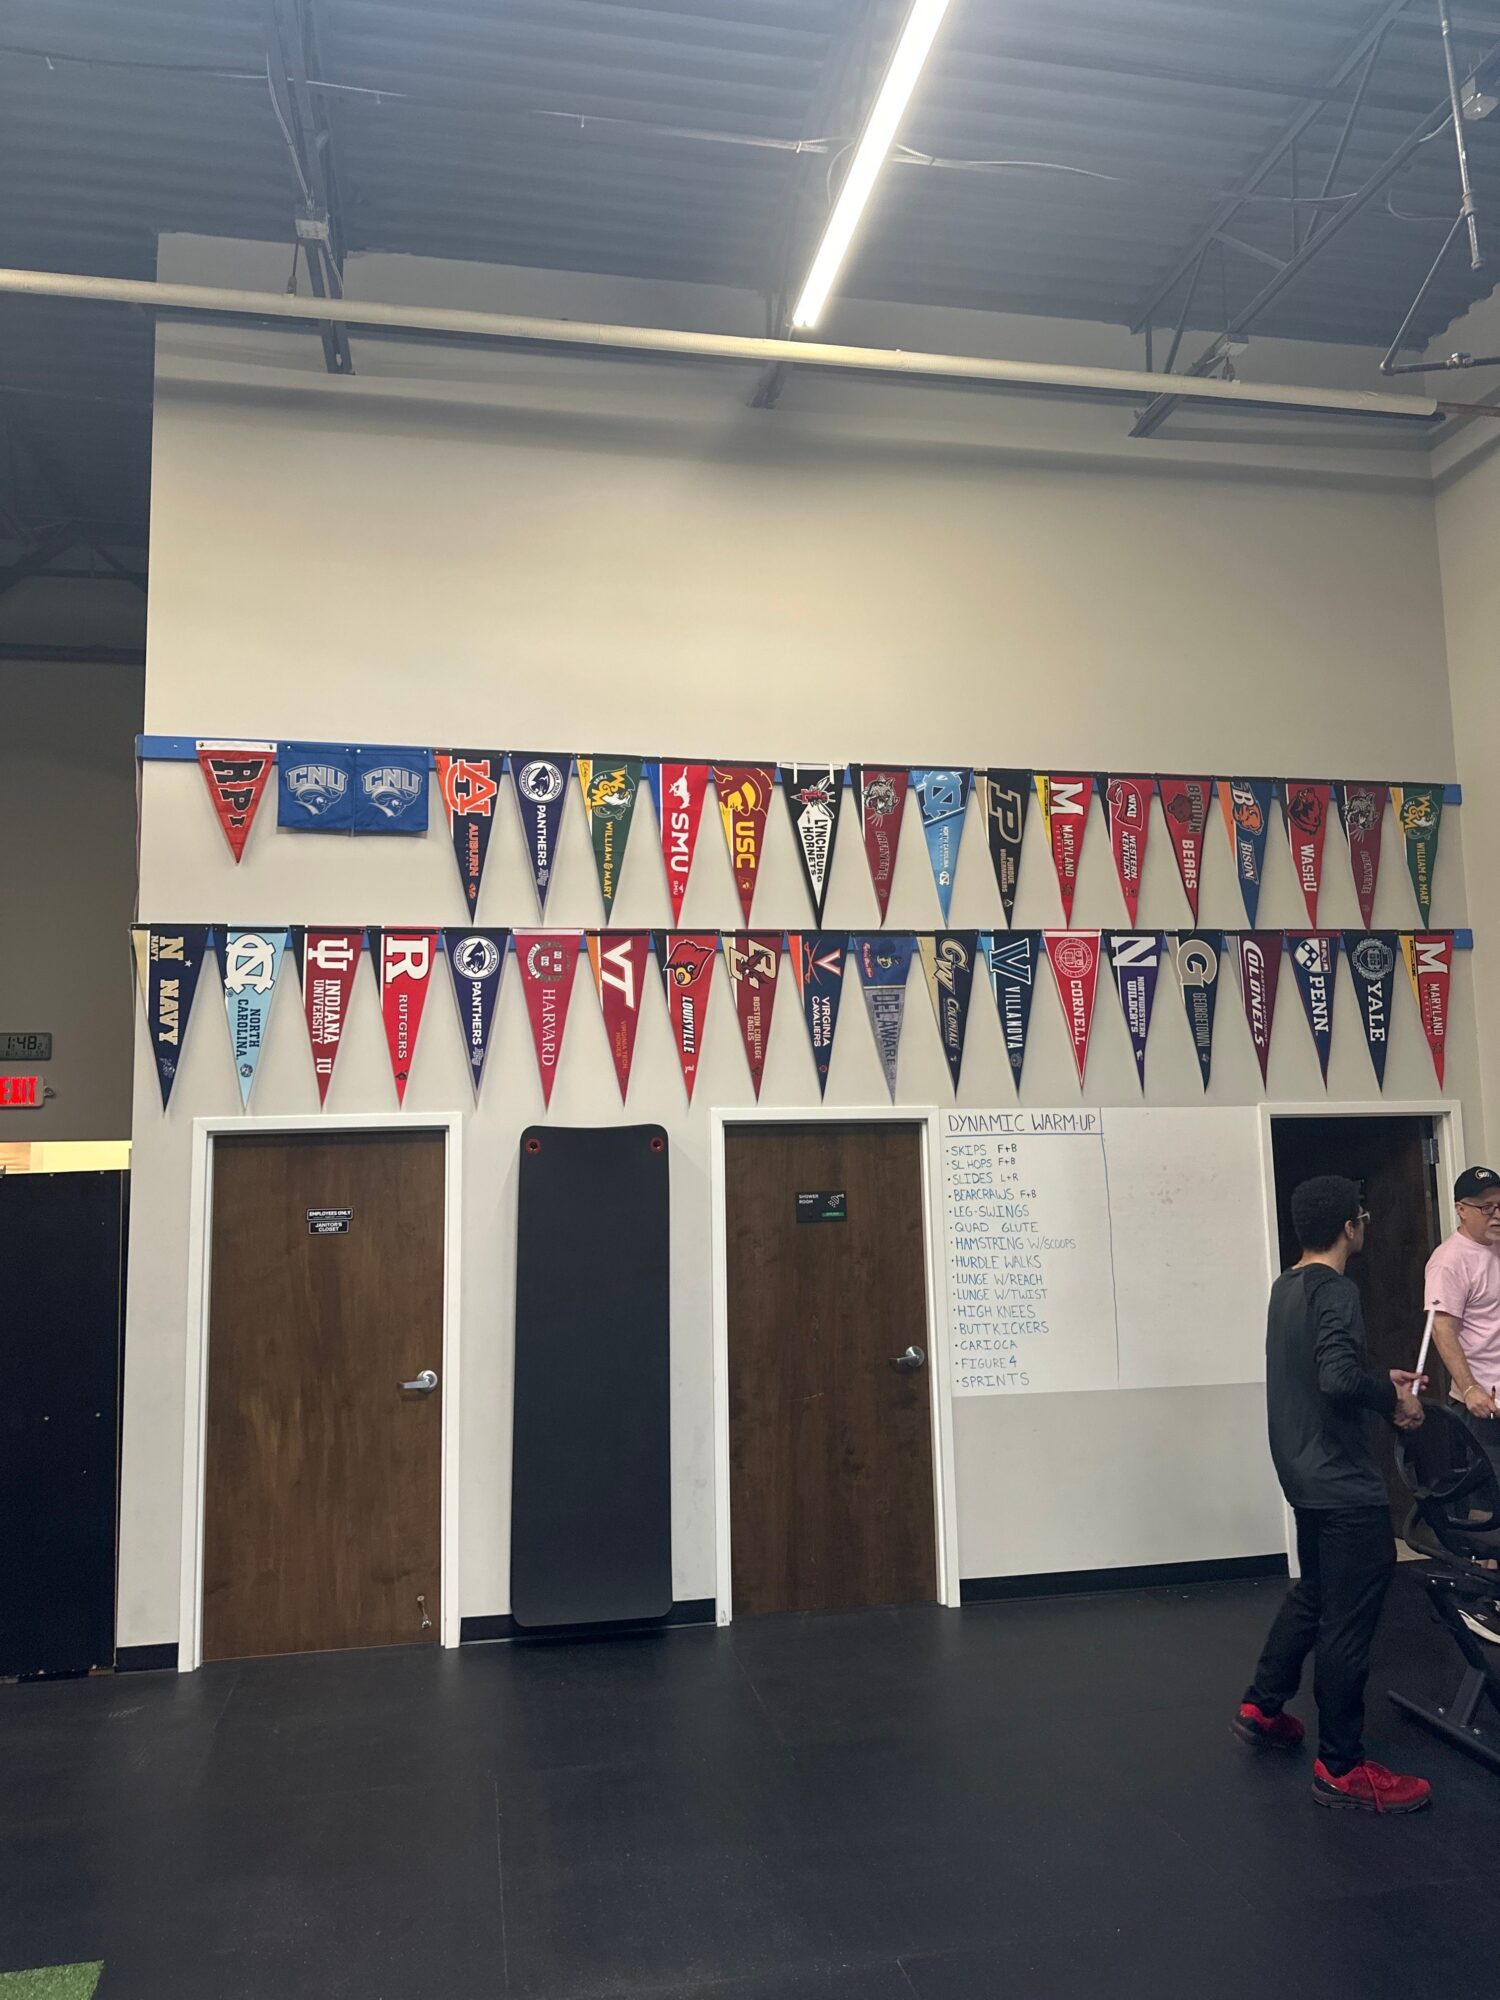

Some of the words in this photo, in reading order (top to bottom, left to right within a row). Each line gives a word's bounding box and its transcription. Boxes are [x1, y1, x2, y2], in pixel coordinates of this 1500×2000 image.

[208, 759, 266, 827] RPI
[286, 765, 349, 790] CNU
[361, 767, 423, 795] CNU
[1050, 781, 1084, 816] M
[987, 780, 1022, 844] P
[1126, 794, 1137, 818] WKU
[468, 823, 480, 877] AUBURN
[536, 804, 547, 867] PANTHERS
[603, 821, 614, 861] WILLIAM
[670, 812, 690, 873] SMU
[735, 821, 756, 869] USC
[802, 826, 817, 876] HORNETS
[814, 819, 828, 883] LYNCHBURG
[1061, 824, 1075, 878] MARYLAND
[1121, 831, 1131, 881] KENTUCKY
[1129, 834, 1138, 879] WESTERN
[1416, 842, 1427, 873] WILLIAM
[603, 870, 612, 899] MARY
[1007, 857, 1015, 884] PURDUE
[1181, 839, 1196, 889] BEARS
[1300, 843, 1317, 892] WASHU
[1420, 884, 1429, 905] MARY
[150, 935, 159, 962] NAVY
[159, 936, 184, 961] N
[385, 936, 430, 984] R
[1110, 936, 1158, 967] N
[1177, 939, 1217, 988] G
[1415, 941, 1448, 974] M
[158, 978, 180, 1045] NAVY
[312, 979, 325, 1044] UNIVERSITY
[323, 979, 341, 1044] INDIANA
[471, 981, 482, 1045] PANTHERS
[752, 996, 761, 1026] BOSTON
[1070, 980, 1086, 1045] CORNELL
[1127, 980, 1139, 1033] WILDCATS
[1136, 976, 1146, 1038] NORTHWESTERN
[1242, 940, 1265, 1047] COLONELS
[1309, 975, 1329, 1032] PENN
[1367, 980, 1385, 1042] YALE
[1428, 983, 1444, 1036] MARYLAND
[236, 998, 249, 1059] CAROLINA
[249, 1008, 261, 1048] NORTH
[397, 994, 408, 1059] RUTGERS
[542, 988, 556, 1066] HARVARD
[682, 996, 695, 1054] LOUISVILLE
[811, 995, 821, 1048] CAVALIERS
[821, 996, 831, 1047] VIRGINIA
[872, 993, 900, 1066] DELAWARE
[1005, 986, 1023, 1049] VILLANOVA
[1192, 992, 1211, 1047] GEORGETOWN
[8, 1035, 37, 1050] 1:48
[754, 1028, 762, 1059] COLLEGE
[316, 1057, 332, 1074] IU
[0, 1076, 38, 1105] EXIT
[948, 1114, 1025, 1132] DYNAMIC
[1031, 1113, 1096, 1132] WARM-UP
[951, 1144, 987, 1156] SKIPS
[997, 1143, 1018, 1154] F+B
[967, 1158, 993, 1169] HOPS
[998, 1157, 1016, 1166] F+B
[952, 1172, 993, 1185] SLIDES
[1020, 1189, 1037, 1199] F+B
[954, 1204, 1030, 1218] LEG-SWINGS
[955, 1222, 990, 1234] QUAD
[1001, 1221, 1039, 1233] GLUTE
[955, 1236, 1024, 1251] HAMSTRING
[955, 1255, 1000, 1269] HURDLE
[1004, 1255, 1042, 1269] WALKS
[956, 1273, 989, 1285] LUNGE
[994, 1273, 1043, 1286] W/REACH
[957, 1289, 990, 1300] LUNGE
[994, 1288, 1048, 1300] W/TWIST
[957, 1305, 993, 1318] HIGH
[997, 1304, 1036, 1318] KNEES
[960, 1339, 1018, 1351] CARIOCA
[961, 1358, 1007, 1369] FIGURE
[1009, 1355, 1017, 1368] 4
[962, 1372, 1030, 1387] SPRINTS
